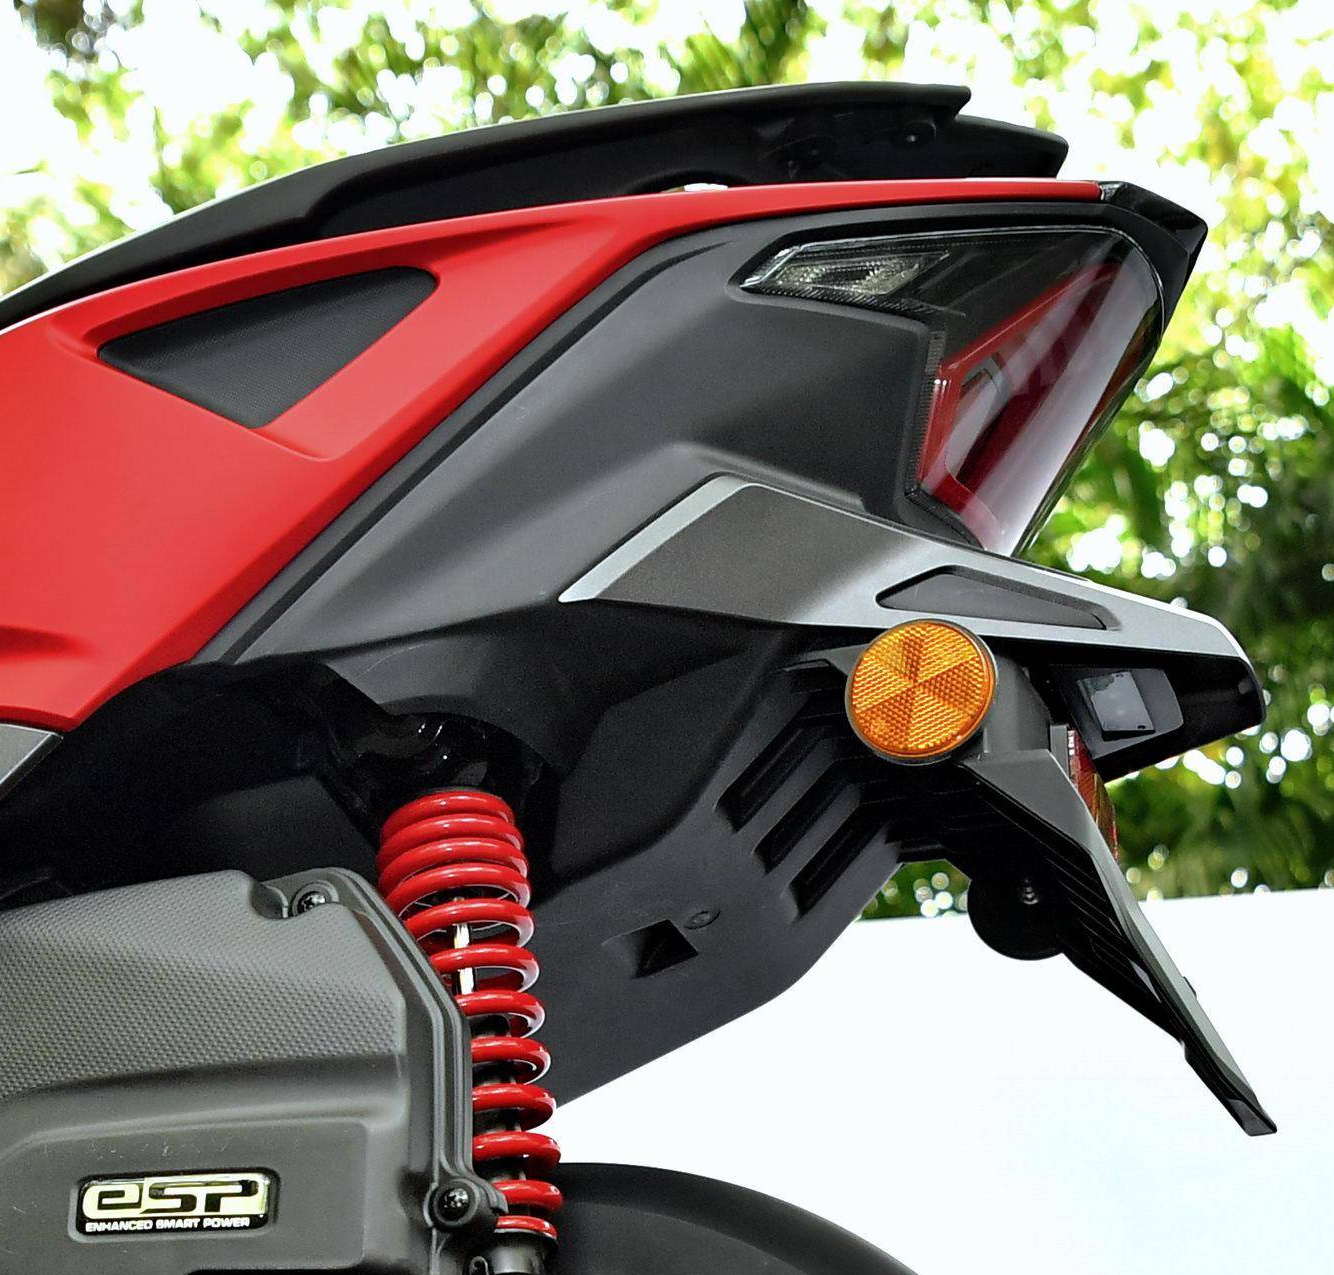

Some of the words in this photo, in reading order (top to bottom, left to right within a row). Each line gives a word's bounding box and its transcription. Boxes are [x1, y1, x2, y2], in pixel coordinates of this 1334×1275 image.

[85, 1219, 153, 1233] ENHANCED
[155, 1217, 201, 1230] SMART
[203, 1216, 250, 1229] POWER
